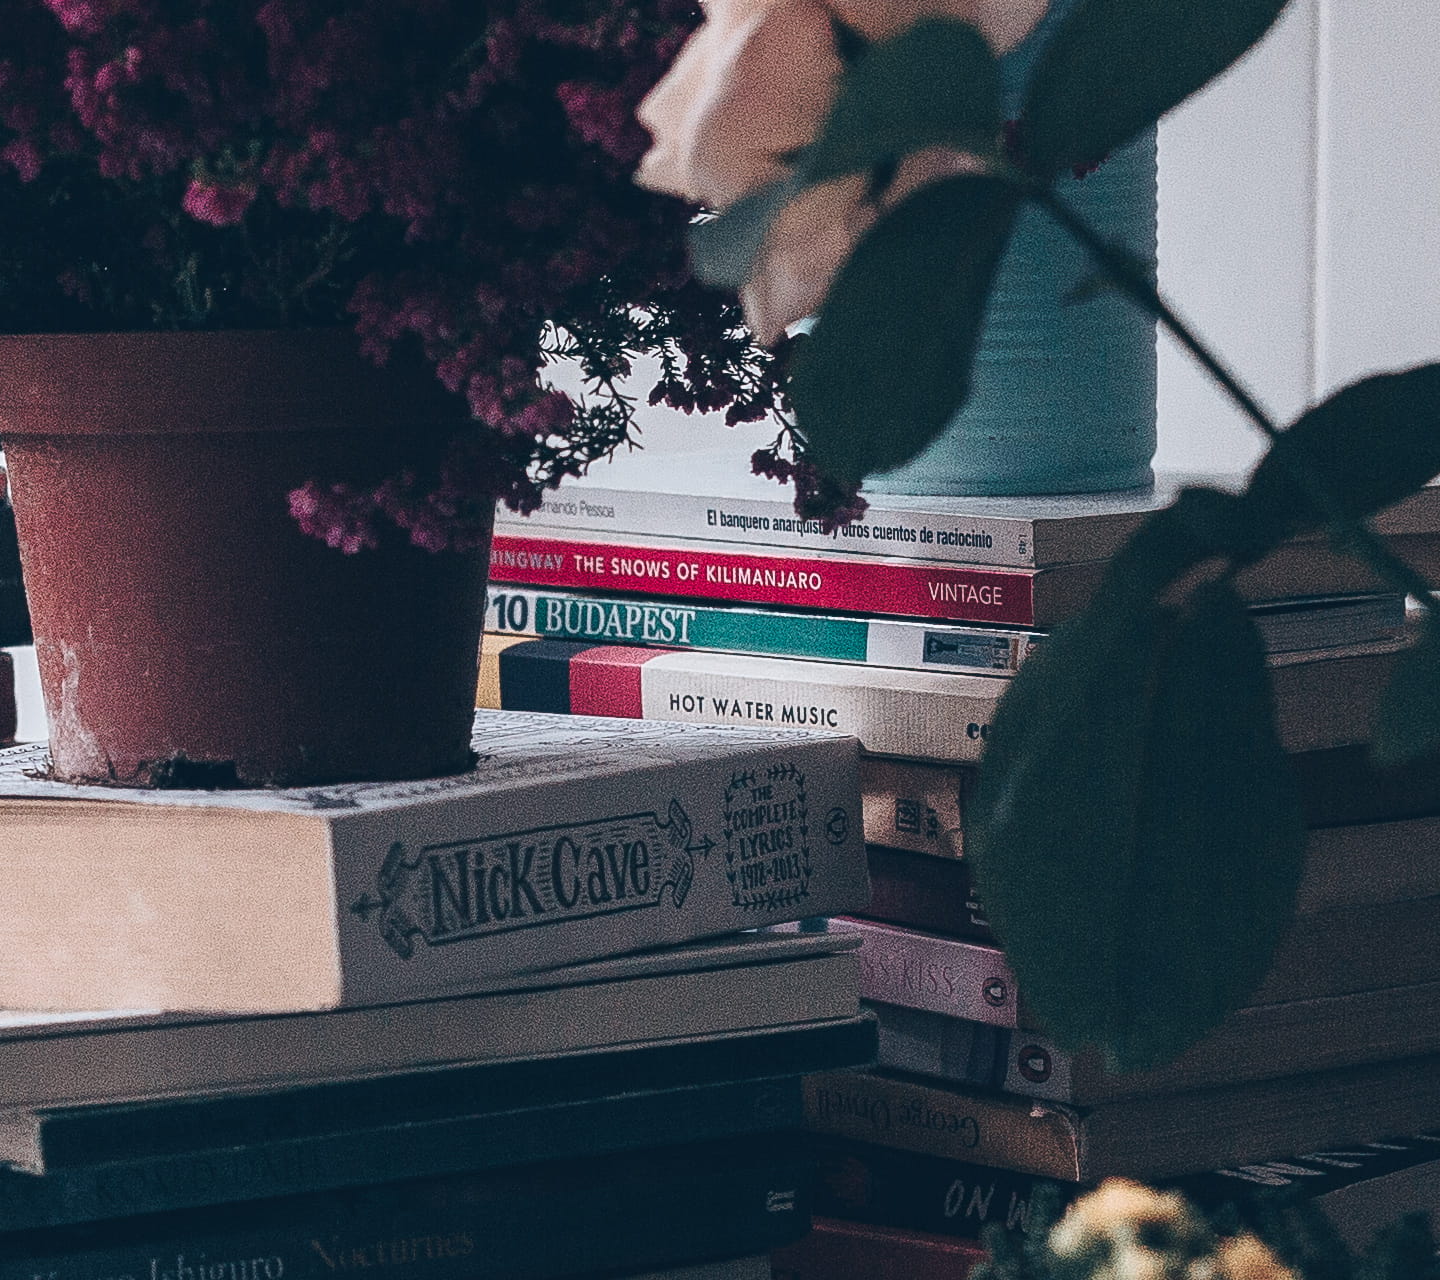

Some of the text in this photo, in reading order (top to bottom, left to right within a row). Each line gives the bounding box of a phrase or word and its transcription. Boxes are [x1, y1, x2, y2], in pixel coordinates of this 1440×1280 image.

[580, 500, 615, 518] Pessoa
[706, 507, 718, 526] El
[721, 509, 769, 534] banquero
[773, 512, 822, 537] anarquist
[842, 523, 870, 539] otros
[872, 526, 917, 543] cuentos
[920, 527, 934, 544] de
[936, 528, 994, 549] raciocinio
[573, 553, 605, 576] THE
[610, 556, 671, 581] SNOWS
[676, 560, 699, 582] OF
[705, 563, 821, 592] KILIMANJARO
[928, 580, 1003, 606] VINTAGE
[545, 598, 697, 644] BUDAPEST
[669, 693, 838, 727] HOT WATER MUSIC
[751, 784, 775, 803] THE
[733, 801, 798, 832] COMPLETE
[738, 827, 794, 861] LYRICS
[428, 835, 651, 937] Nick Cave
[899, 1100, 981, 1149] George
[943, 1179, 995, 1221] ON
[310, 1226, 476, 1276] Nocturnes
